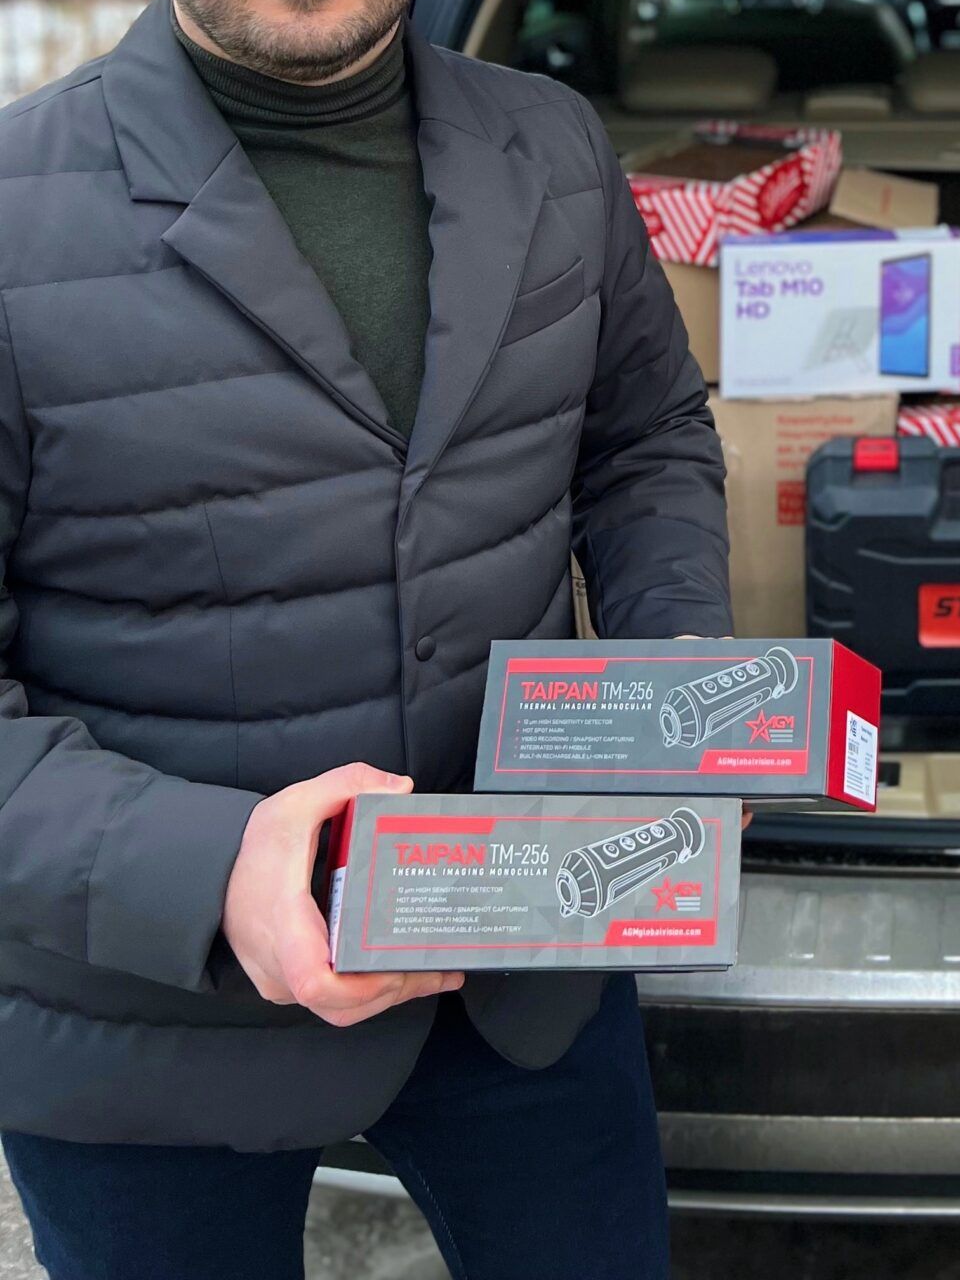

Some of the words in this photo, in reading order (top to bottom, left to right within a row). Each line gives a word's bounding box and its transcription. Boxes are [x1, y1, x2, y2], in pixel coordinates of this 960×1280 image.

[735, 259, 812, 276] Lenovo
[736, 279, 774, 298] Tab
[781, 278, 824, 297] M10
[736, 302, 770, 319] HD
[520, 681, 598, 700] TAIPAN
[601, 681, 654, 700] TM-256
[519, 702, 556, 710] THERMAL
[561, 702, 597, 710] IMAGING
[601, 702, 652, 710] MONOCULAR
[394, 843, 486, 865] TAIPAN
[490, 844, 549, 865] TM-256
[392, 868, 437, 876] THERMAL
[442, 868, 484, 876] IMAGING
[490, 868, 548, 876] MONOCULAR
